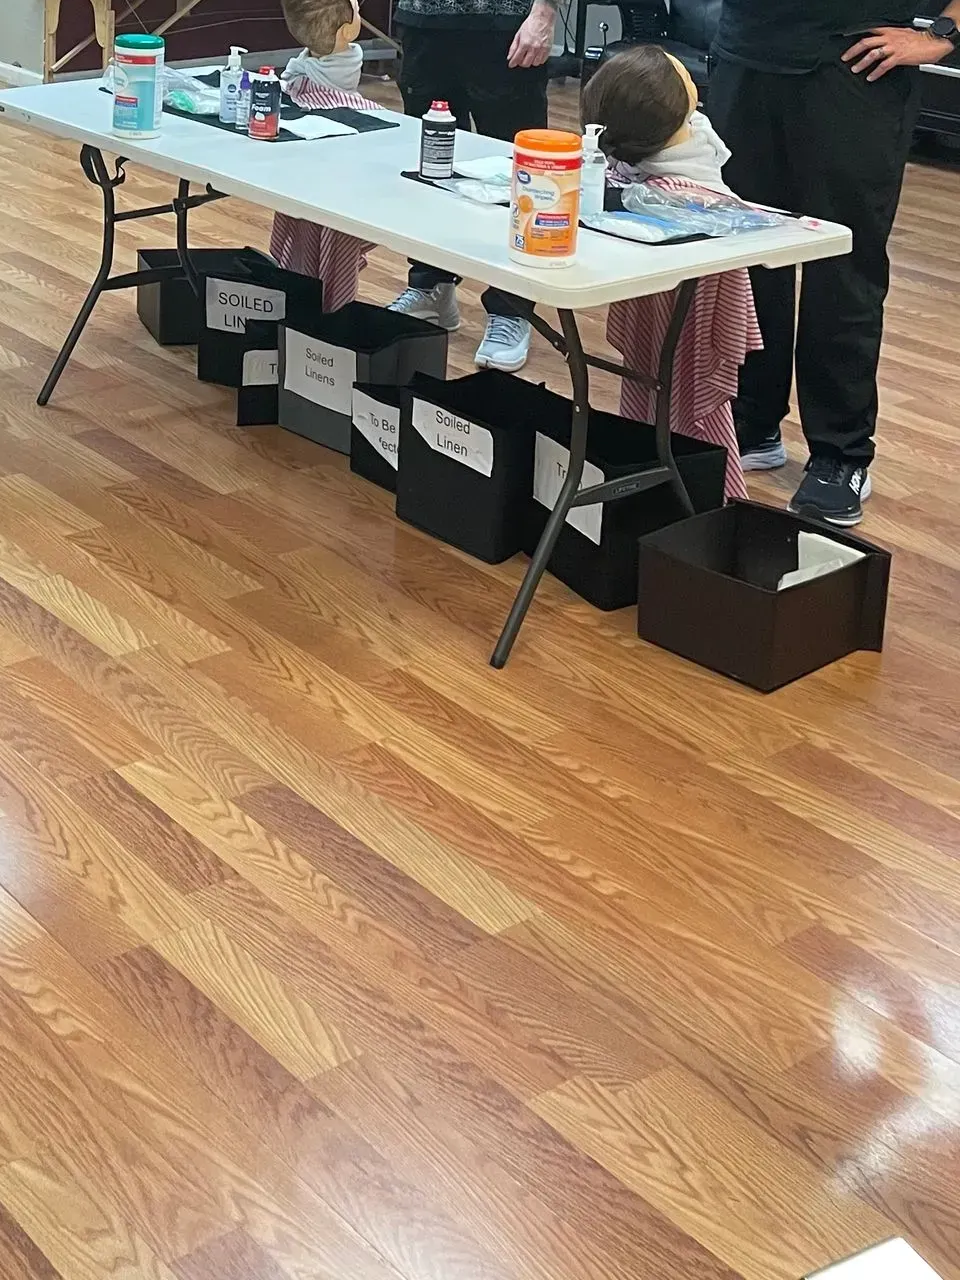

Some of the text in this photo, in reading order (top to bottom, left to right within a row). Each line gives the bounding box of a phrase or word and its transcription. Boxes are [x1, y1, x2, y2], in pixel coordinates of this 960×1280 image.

[251, 103, 272, 112] Foam
[218, 292, 273, 313] SOILED
[305, 348, 334, 367] Soiled
[305, 365, 336, 387] Linens
[369, 412, 396, 433] To Be
[435, 410, 471, 434] Soiled
[436, 432, 468, 456] Linen
